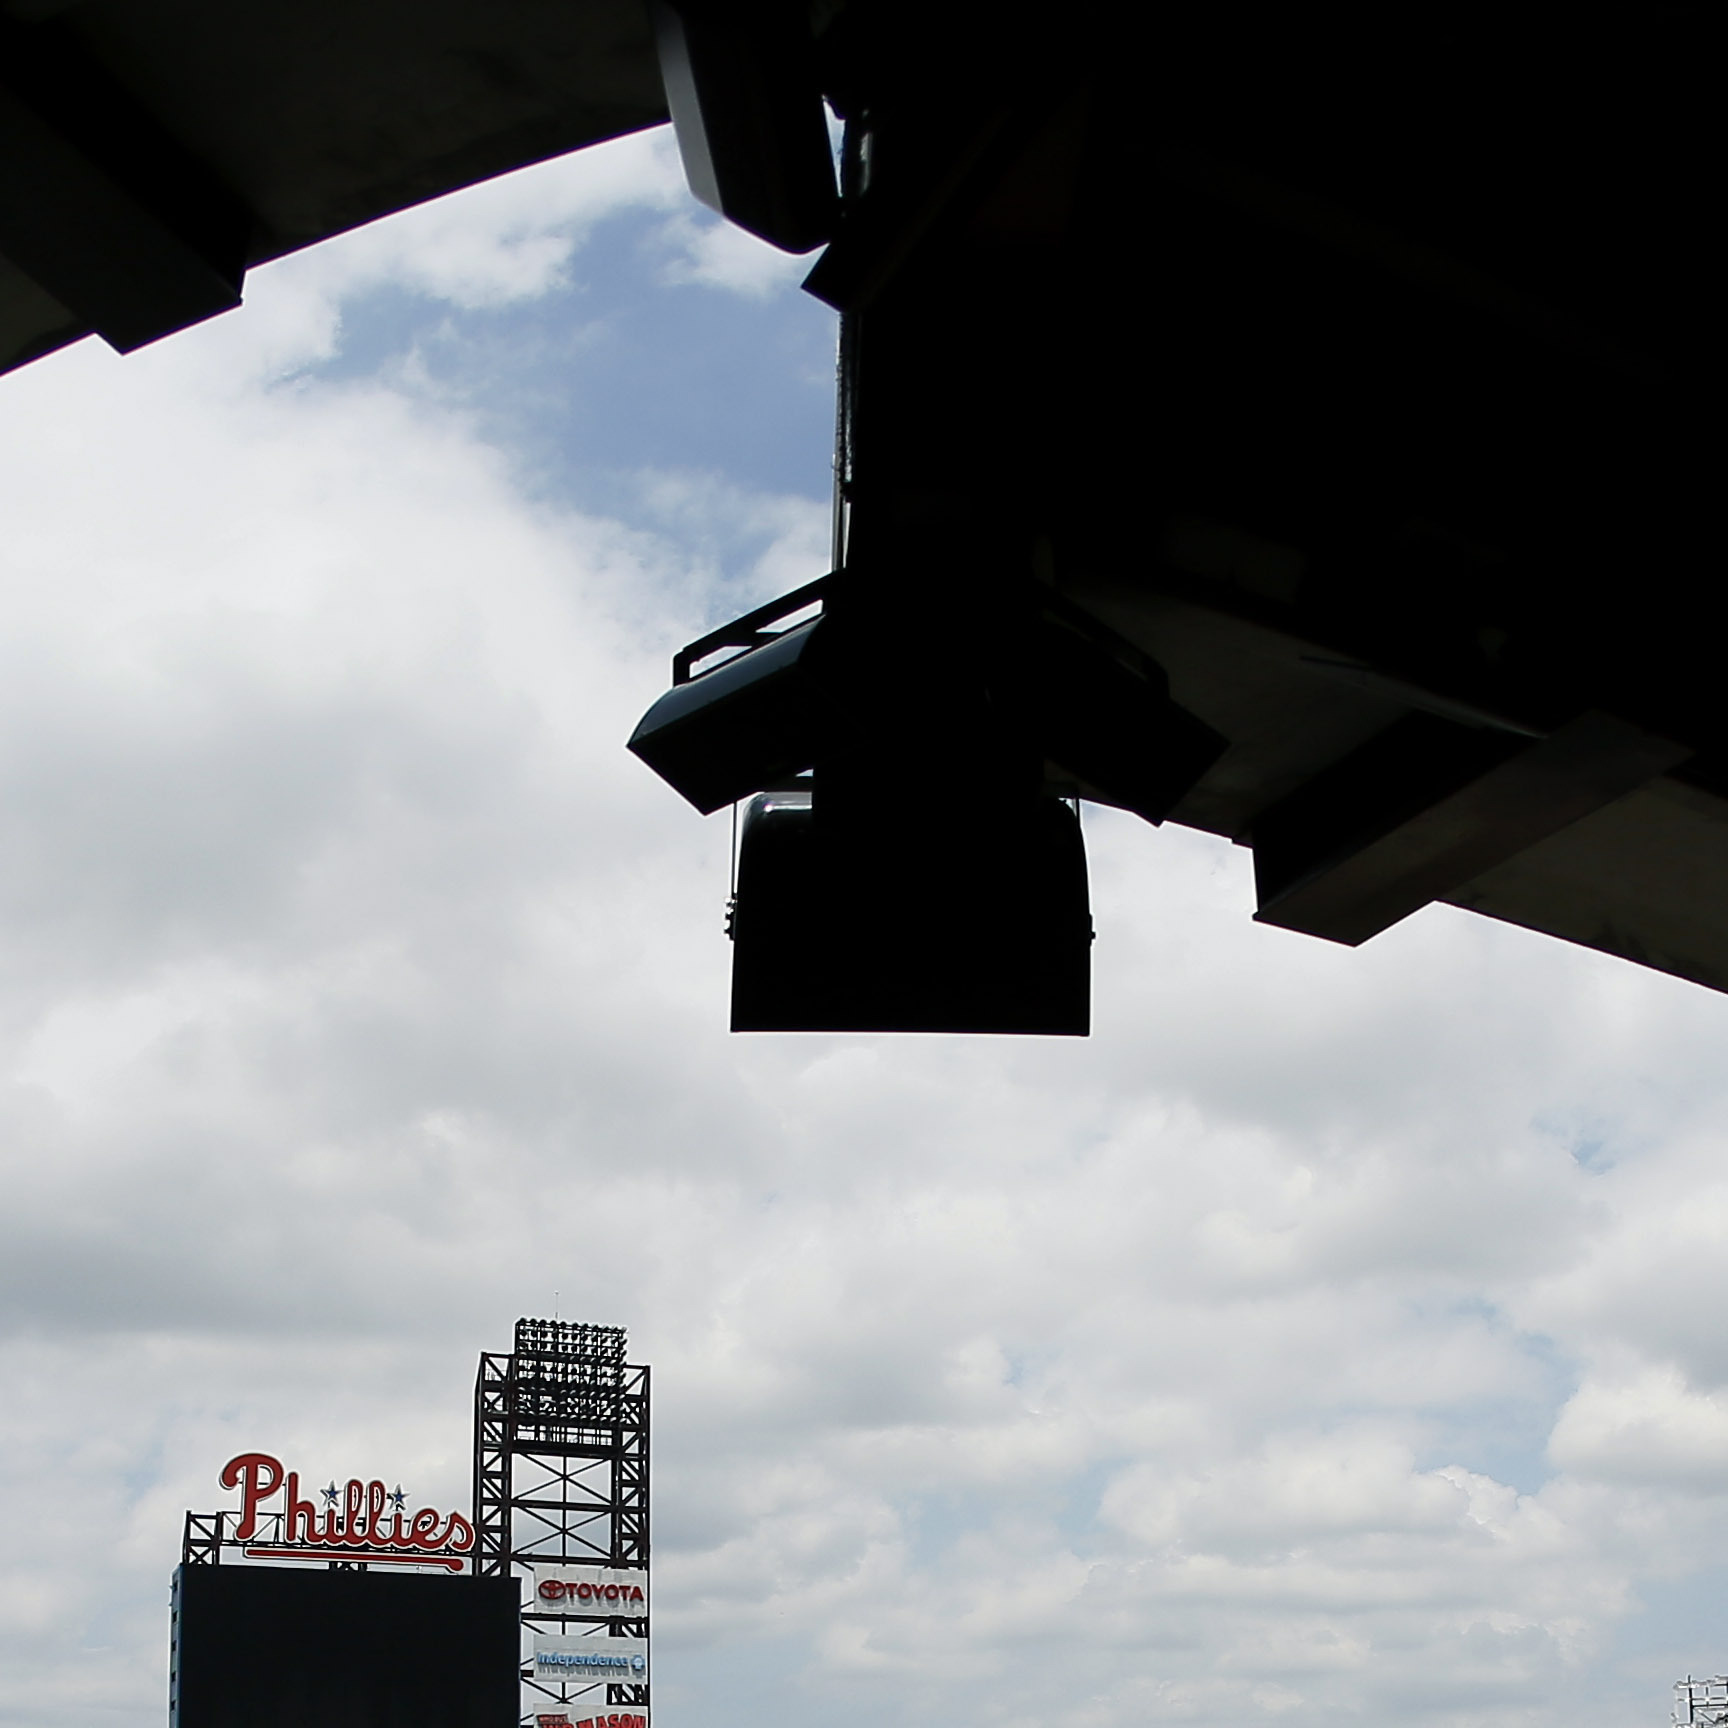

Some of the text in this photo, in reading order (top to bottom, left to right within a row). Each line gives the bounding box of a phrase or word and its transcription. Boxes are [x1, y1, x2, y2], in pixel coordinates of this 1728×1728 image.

[220, 1453, 476, 1550] Phillies
[565, 1583, 644, 1601] TOYOTA
[537, 1652, 629, 1667] Independence
